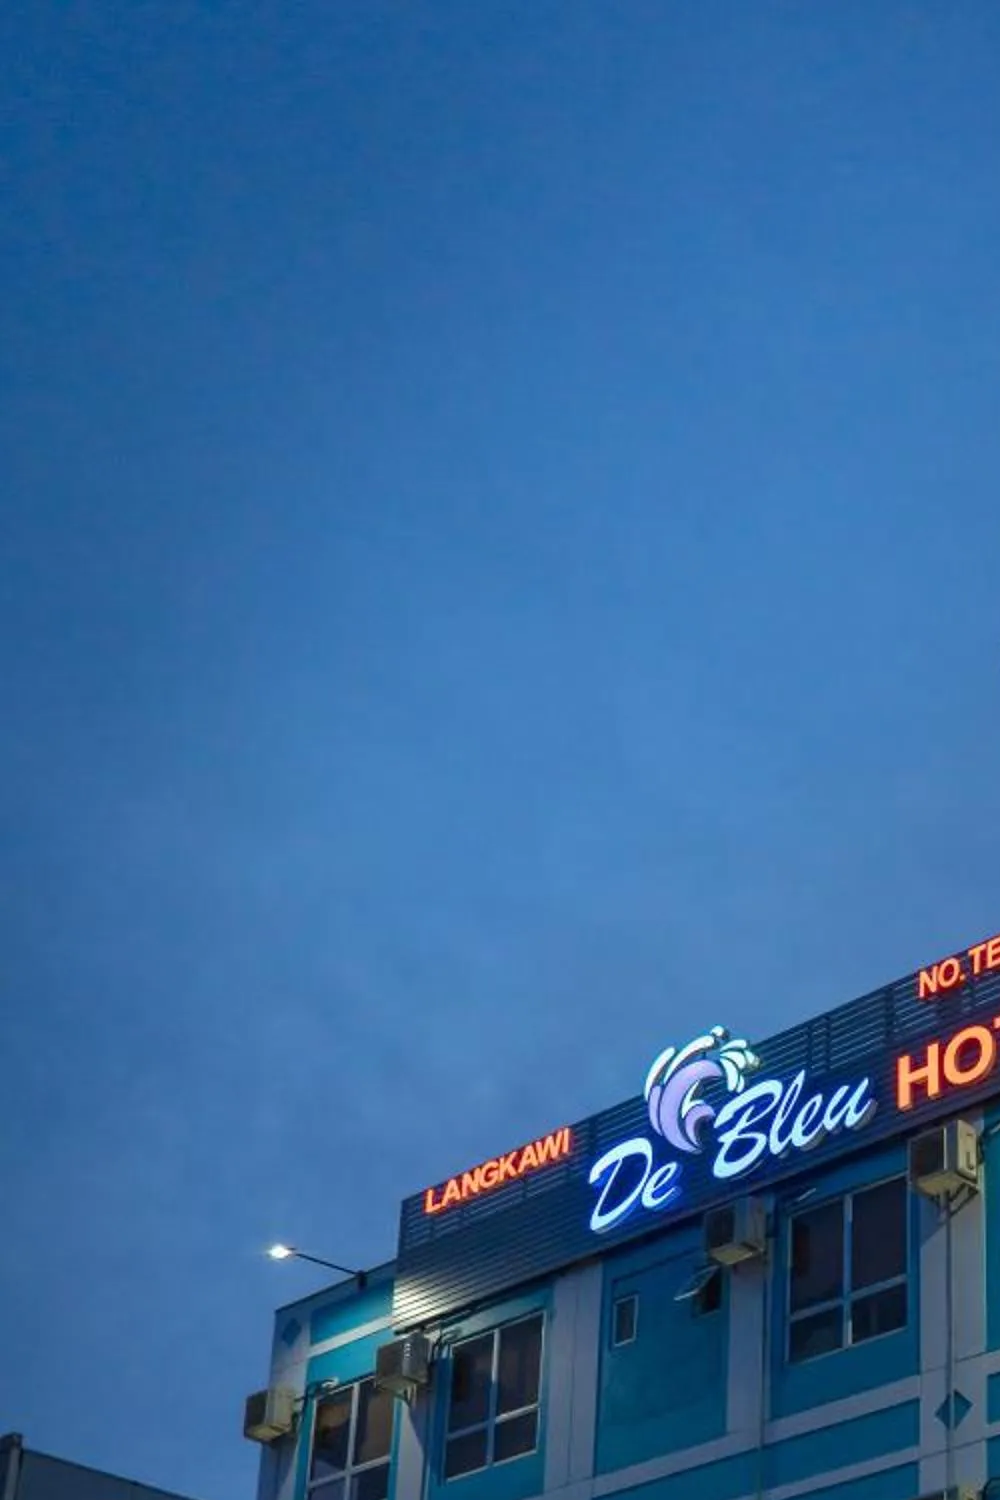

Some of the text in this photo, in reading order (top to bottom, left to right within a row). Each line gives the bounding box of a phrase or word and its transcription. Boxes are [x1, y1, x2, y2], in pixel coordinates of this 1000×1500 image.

[423, 1127, 572, 1215] LANGKAWI
[588, 1070, 872, 1234] De Bleu
